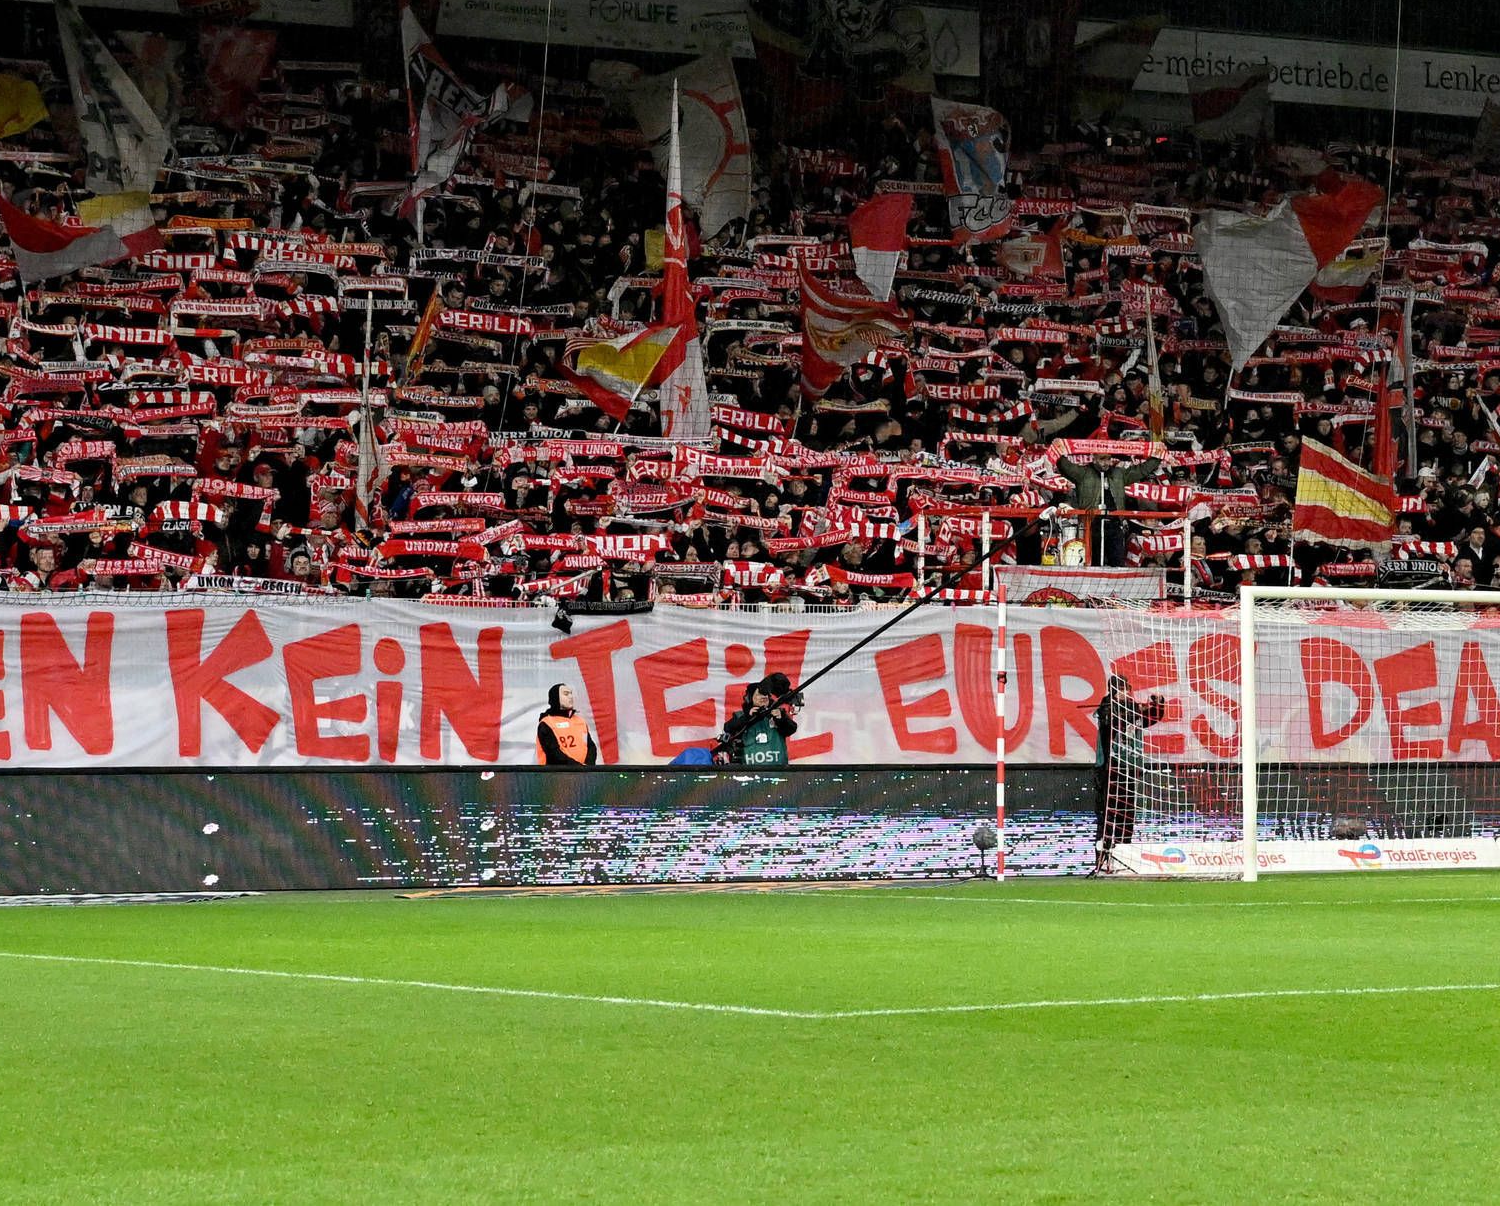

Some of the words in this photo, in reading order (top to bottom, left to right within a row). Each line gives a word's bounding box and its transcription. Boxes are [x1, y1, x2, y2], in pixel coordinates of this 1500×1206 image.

[1424, 61, 1500, 93] Lenke
[439, 310, 533, 334] BERLIN
[927, 384, 1001, 400] BERLIN
[404, 541, 459, 555] UNIONER
[198, 575, 235, 589] UNION
[559, 735, 577, 749] 82
[745, 750, 781, 765] HOST
[1189, 851, 1287, 867] TotalEngies
[1383, 849, 1477, 865] TotalEnergies
